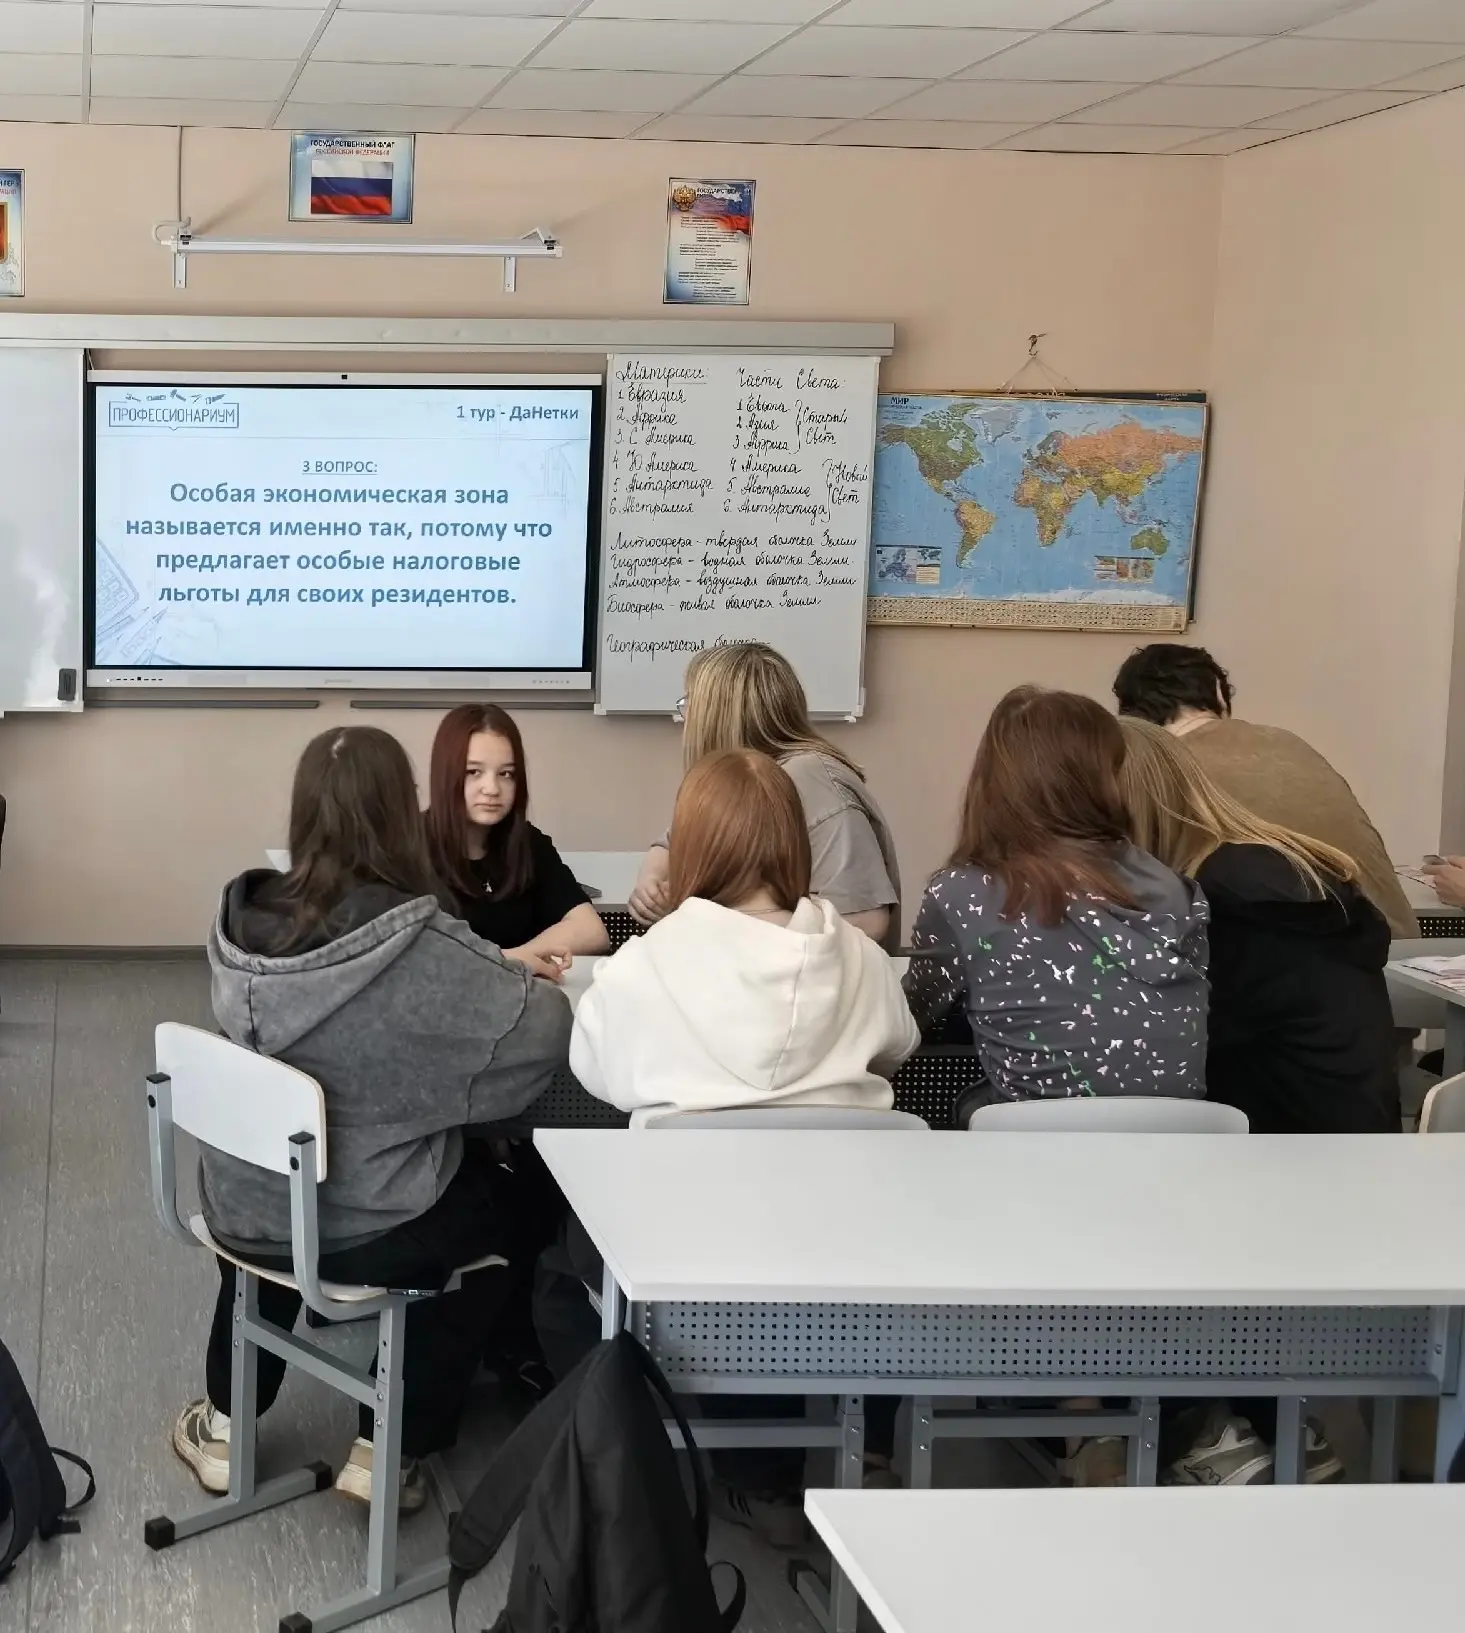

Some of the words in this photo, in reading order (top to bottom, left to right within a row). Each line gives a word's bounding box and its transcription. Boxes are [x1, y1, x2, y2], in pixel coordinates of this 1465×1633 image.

[310, 139, 376, 148] ГОСУДАРСТВЕННЫЙ
[628, 382, 687, 413] Евразия
[890, 396, 909, 405] МИР
[113, 407, 235, 423] ПРОФЕССИОНАРИУМ
[456, 405, 465, 419] 1
[470, 408, 496, 422] тур
[509, 405, 579, 422] ДаНетки
[302, 460, 310, 473] 3
[315, 460, 378, 473] ВОПРОС:
[646, 451, 697, 479] Америка
[741, 454, 802, 478] Америка
[169, 482, 256, 504] Особая
[263, 486, 447, 505] экономическая
[453, 487, 509, 504] зона
[125, 519, 261, 538] называется
[269, 520, 362, 538] именно
[368, 520, 413, 541] так,
[420, 520, 507, 542] потому
[514, 520, 553, 538] что
[610, 531, 693, 554] Литосфера
[156, 552, 291, 574] предлагает
[297, 548, 385, 571] особые
[392, 552, 521, 571] налоговые
[610, 553, 683, 577] Гидросфера
[608, 572, 681, 594] Атмосфера
[158, 586, 240, 605] льготы
[246, 586, 291, 606] для
[297, 586, 364, 604] своих
[371, 587, 517, 607] резидентов.
[606, 593, 665, 620] Биосфера
